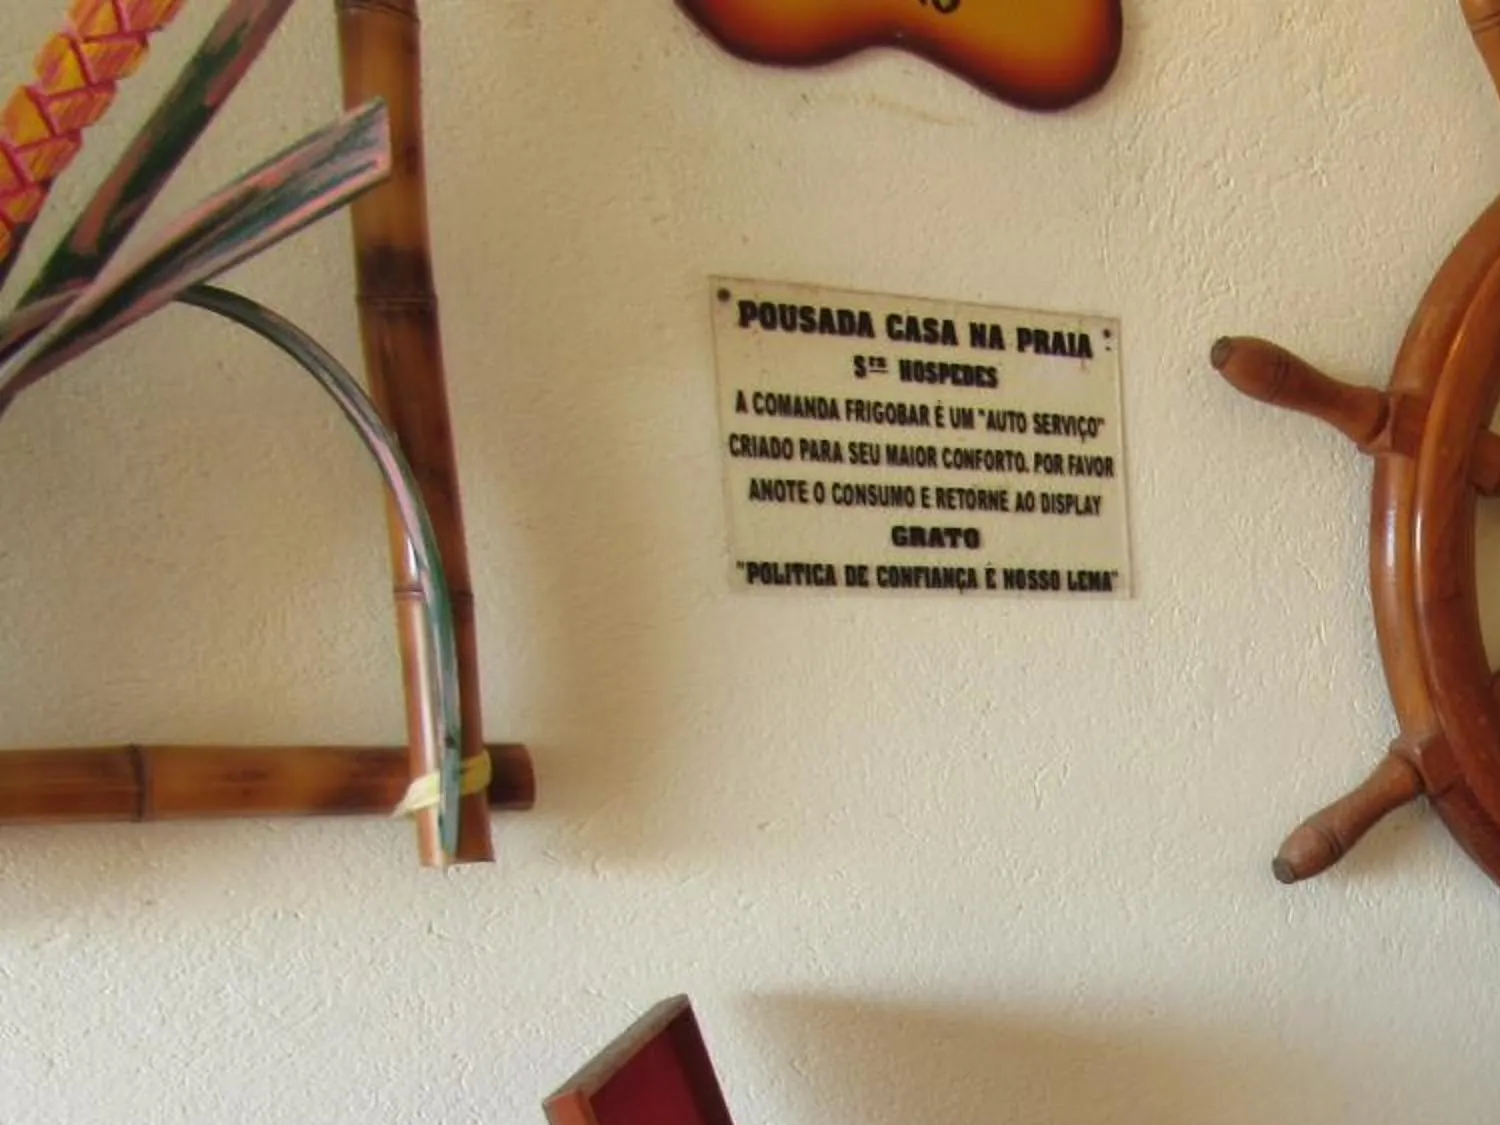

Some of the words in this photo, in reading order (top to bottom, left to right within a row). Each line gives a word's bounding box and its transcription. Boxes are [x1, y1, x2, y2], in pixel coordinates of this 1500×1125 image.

[738, 300, 875, 338] POUSADA
[886, 313, 959, 346] CASA
[969, 321, 1005, 350] NA
[1016, 327, 1094, 358] PRAIA
[899, 359, 998, 388] HOSPEDES
[735, 389, 748, 413] A
[753, 391, 841, 421] COMANDA
[845, 398, 931, 427] FRIGOBAR
[935, 400, 944, 428] É
[950, 406, 975, 430] UM
[978, 407, 1028, 434] "AUTO
[1033, 411, 1105, 443] SERVIÇO"
[729, 433, 794, 460] CRIADO
[800, 438, 843, 463] PARA
[848, 441, 881, 465] SEU
[886, 443, 937, 468] MAIOR
[942, 447, 1029, 473] CONFORTO.
[1033, 452, 1064, 476] POR
[1068, 453, 1114, 477] FAVOR
[749, 478, 809, 504] ANOTE
[813, 481, 825, 505] O
[831, 481, 915, 508] CONSUMO
[920, 486, 930, 509] E
[936, 486, 1009, 512] RETORNE
[1015, 490, 1035, 513] AO
[1041, 492, 1101, 515] DISPLAY
[892, 525, 981, 549] GRATO
[845, 564, 869, 588] DE
[876, 565, 978, 594] CONFIANÇA
[985, 561, 997, 589] É
[1003, 567, 1060, 591] NOSSO
[1068, 570, 1119, 592] LEMA"
